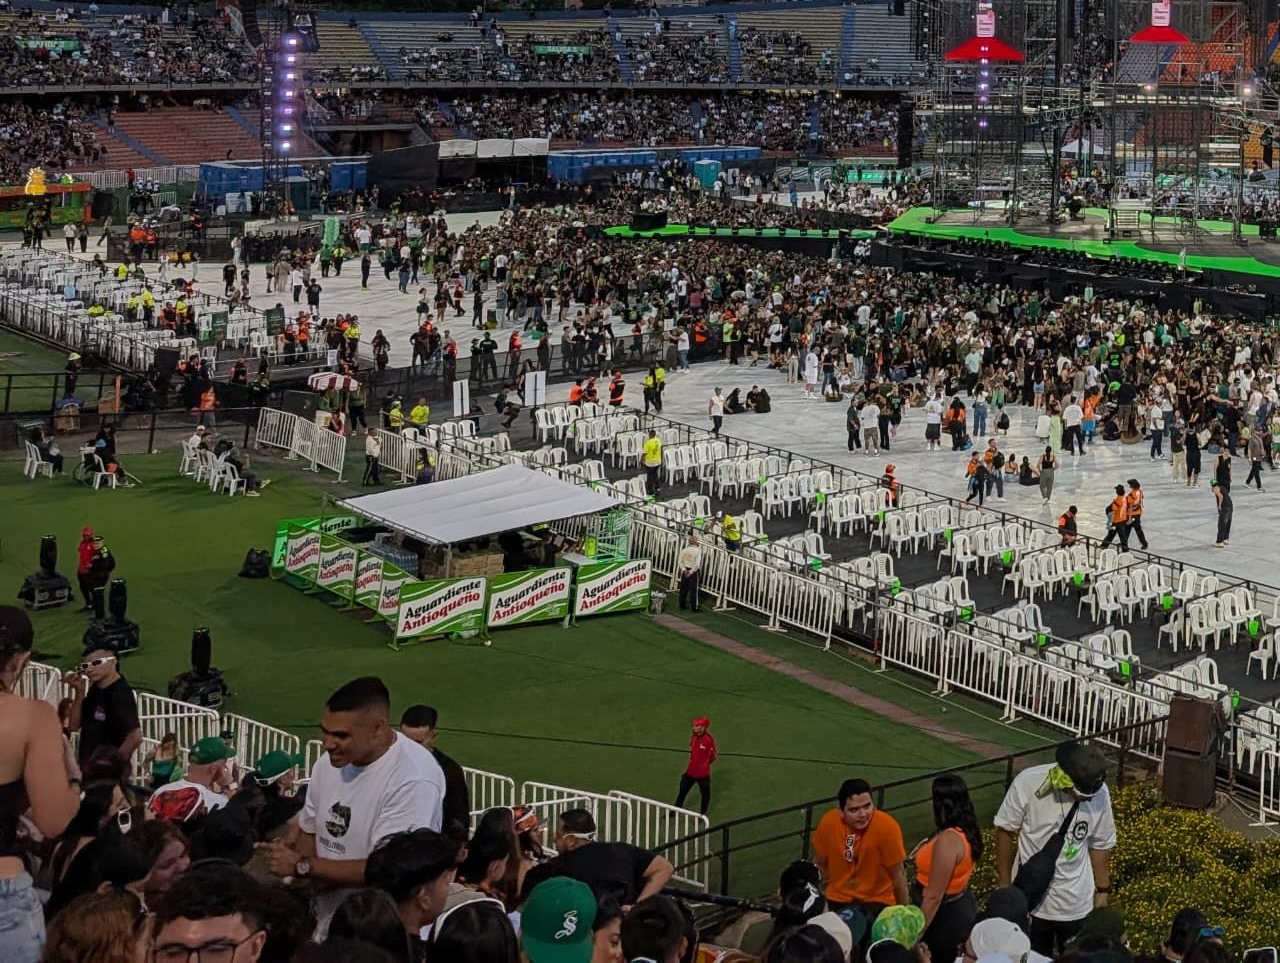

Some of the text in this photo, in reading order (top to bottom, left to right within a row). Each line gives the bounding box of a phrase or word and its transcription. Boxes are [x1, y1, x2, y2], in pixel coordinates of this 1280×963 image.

[288, 545, 319, 567] Antioqueño
[289, 536, 320, 558] Aguardiente
[321, 551, 355, 570] Aguardiente
[319, 561, 354, 580] Antioqueño
[582, 562, 647, 599] Aguardiente
[405, 581, 481, 619] Aguardiente
[492, 582, 566, 622] Antioqueño
[495, 571, 566, 609] Aguardiente
[580, 572, 647, 611] Antioqueño
[402, 592, 480, 632] Antioqueño
